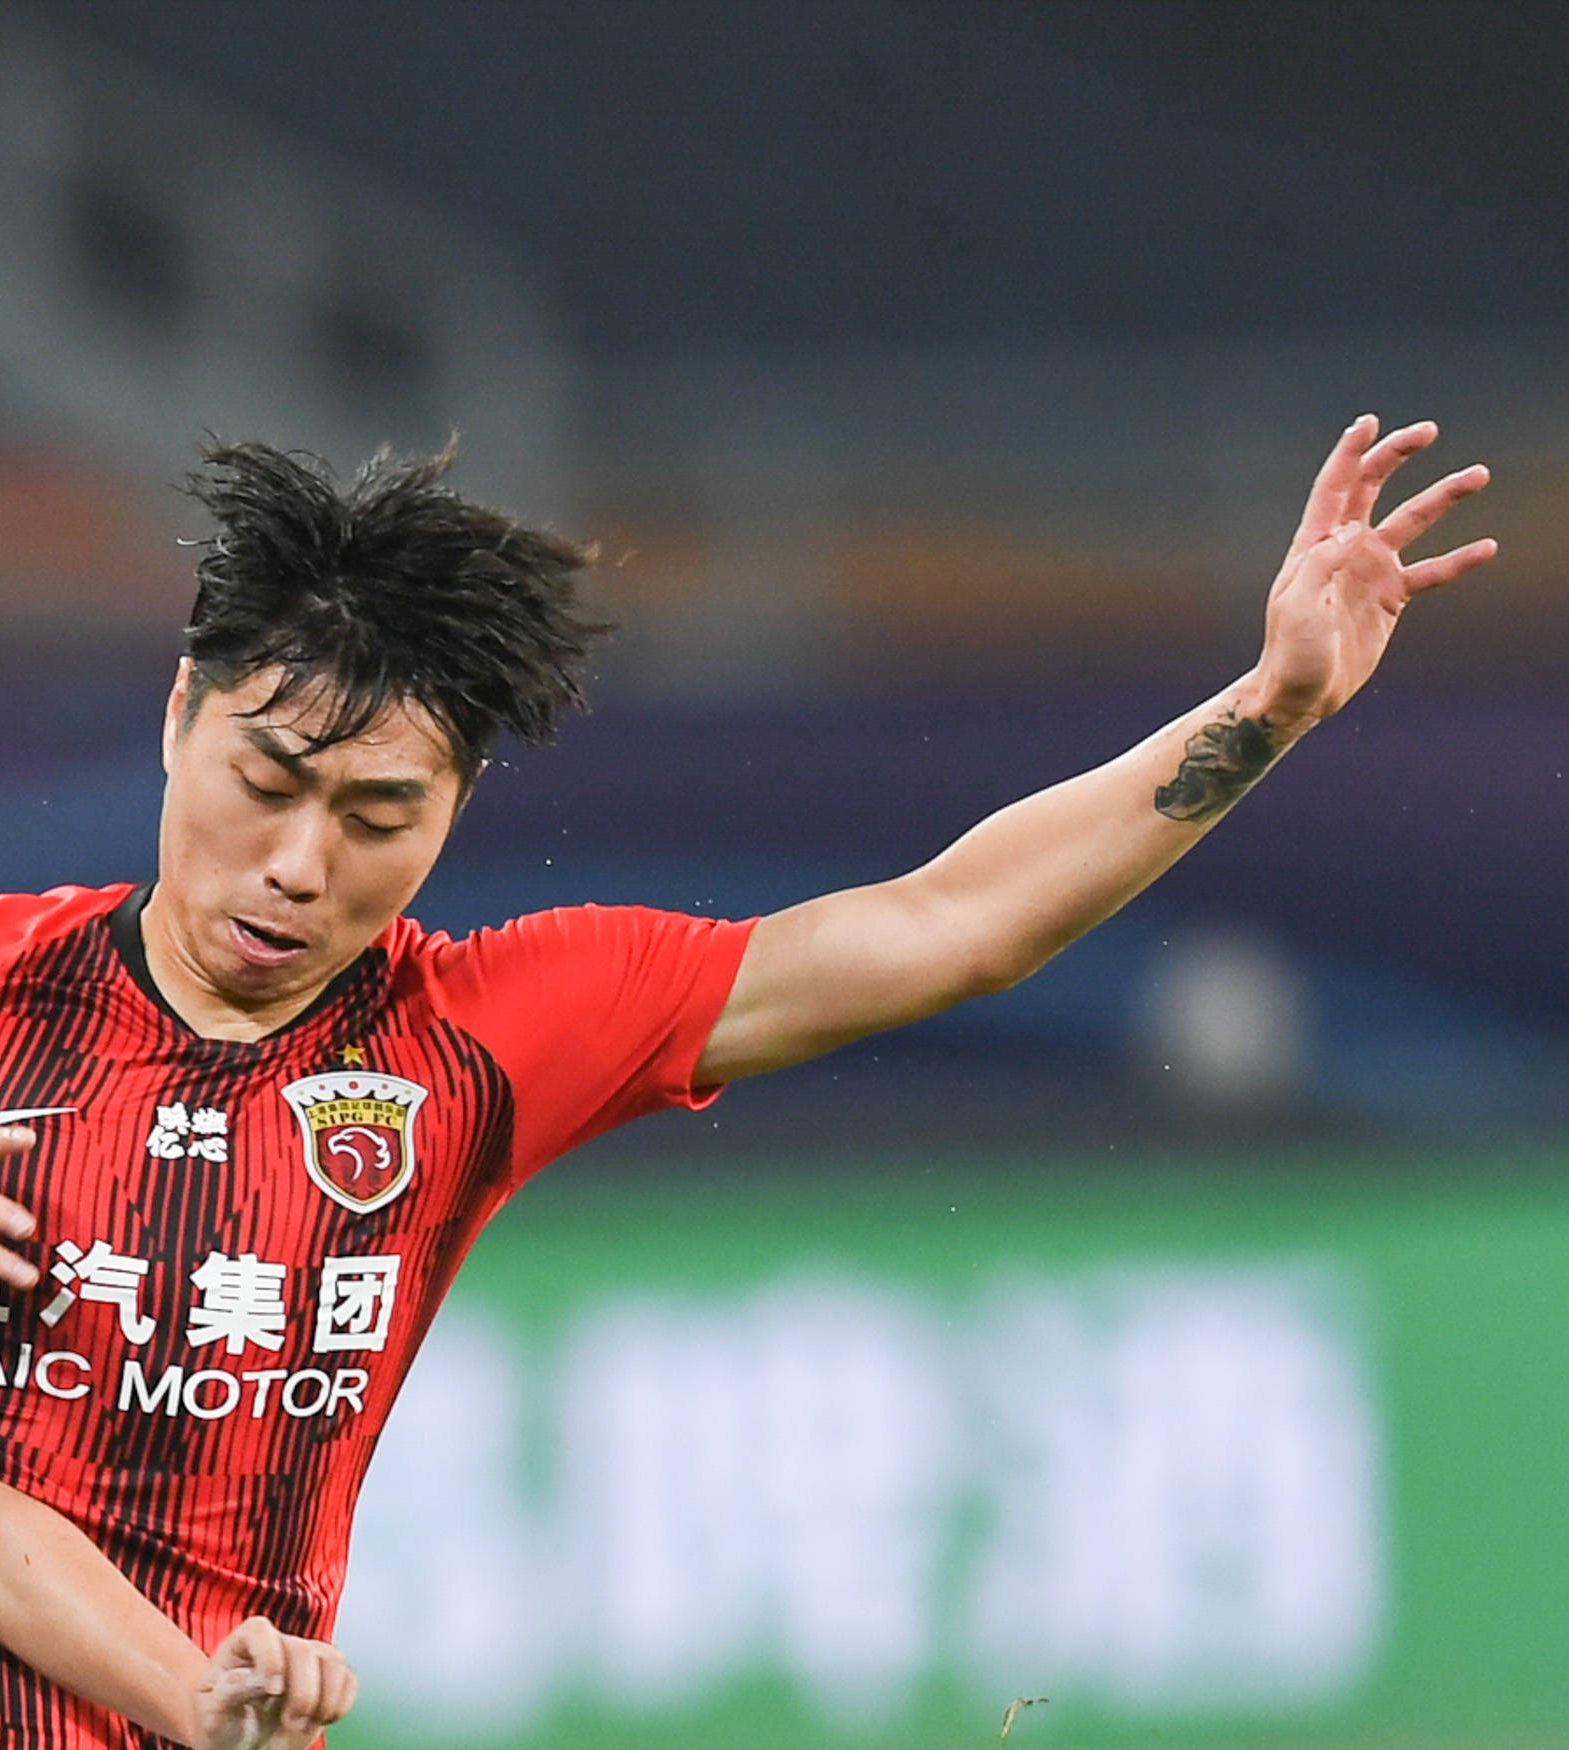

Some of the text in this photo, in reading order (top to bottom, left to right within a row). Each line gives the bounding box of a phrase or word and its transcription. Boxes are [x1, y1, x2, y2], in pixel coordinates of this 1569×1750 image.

[317, 1111, 397, 1127] SIPG FC
[117, 1359, 370, 1420] MOTOR
